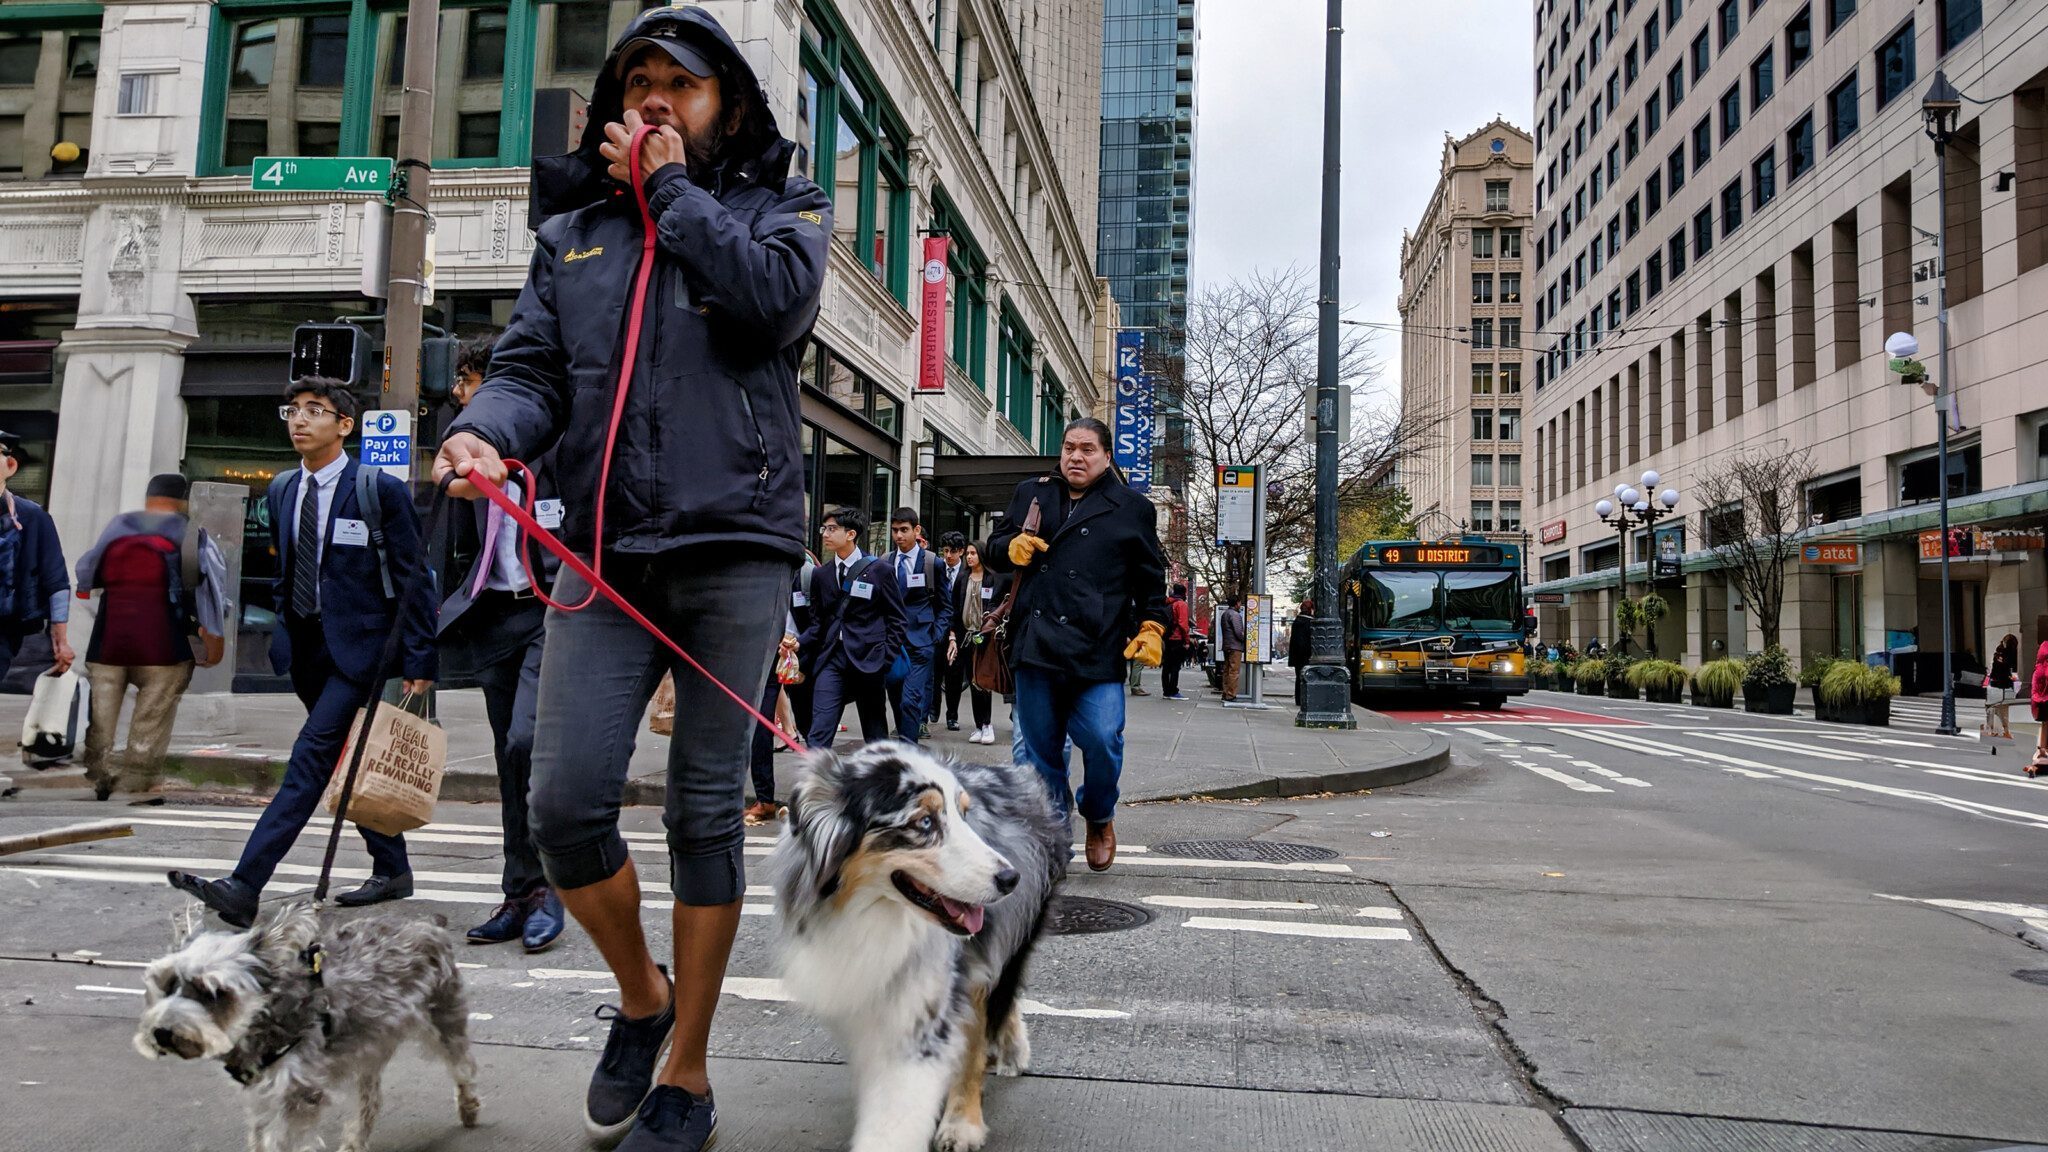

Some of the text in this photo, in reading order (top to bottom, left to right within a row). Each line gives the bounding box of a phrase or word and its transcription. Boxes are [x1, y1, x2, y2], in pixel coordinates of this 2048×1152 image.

[261, 161, 378, 186] 4th Ave
[926, 291, 938, 382] RESTAURANT
[1118, 346, 1138, 455] ROSS
[365, 439, 408, 452] Pay to
[370, 451, 401, 463] Park
[1386, 549, 1470, 562] 49 U DISTRICT
[1822, 547, 1853, 560] at&t
[390, 718, 429, 749] REAL
[380, 749, 435, 780] IS REALLY
[390, 737, 430, 765] FOOD
[366, 758, 433, 793] REWARDING
